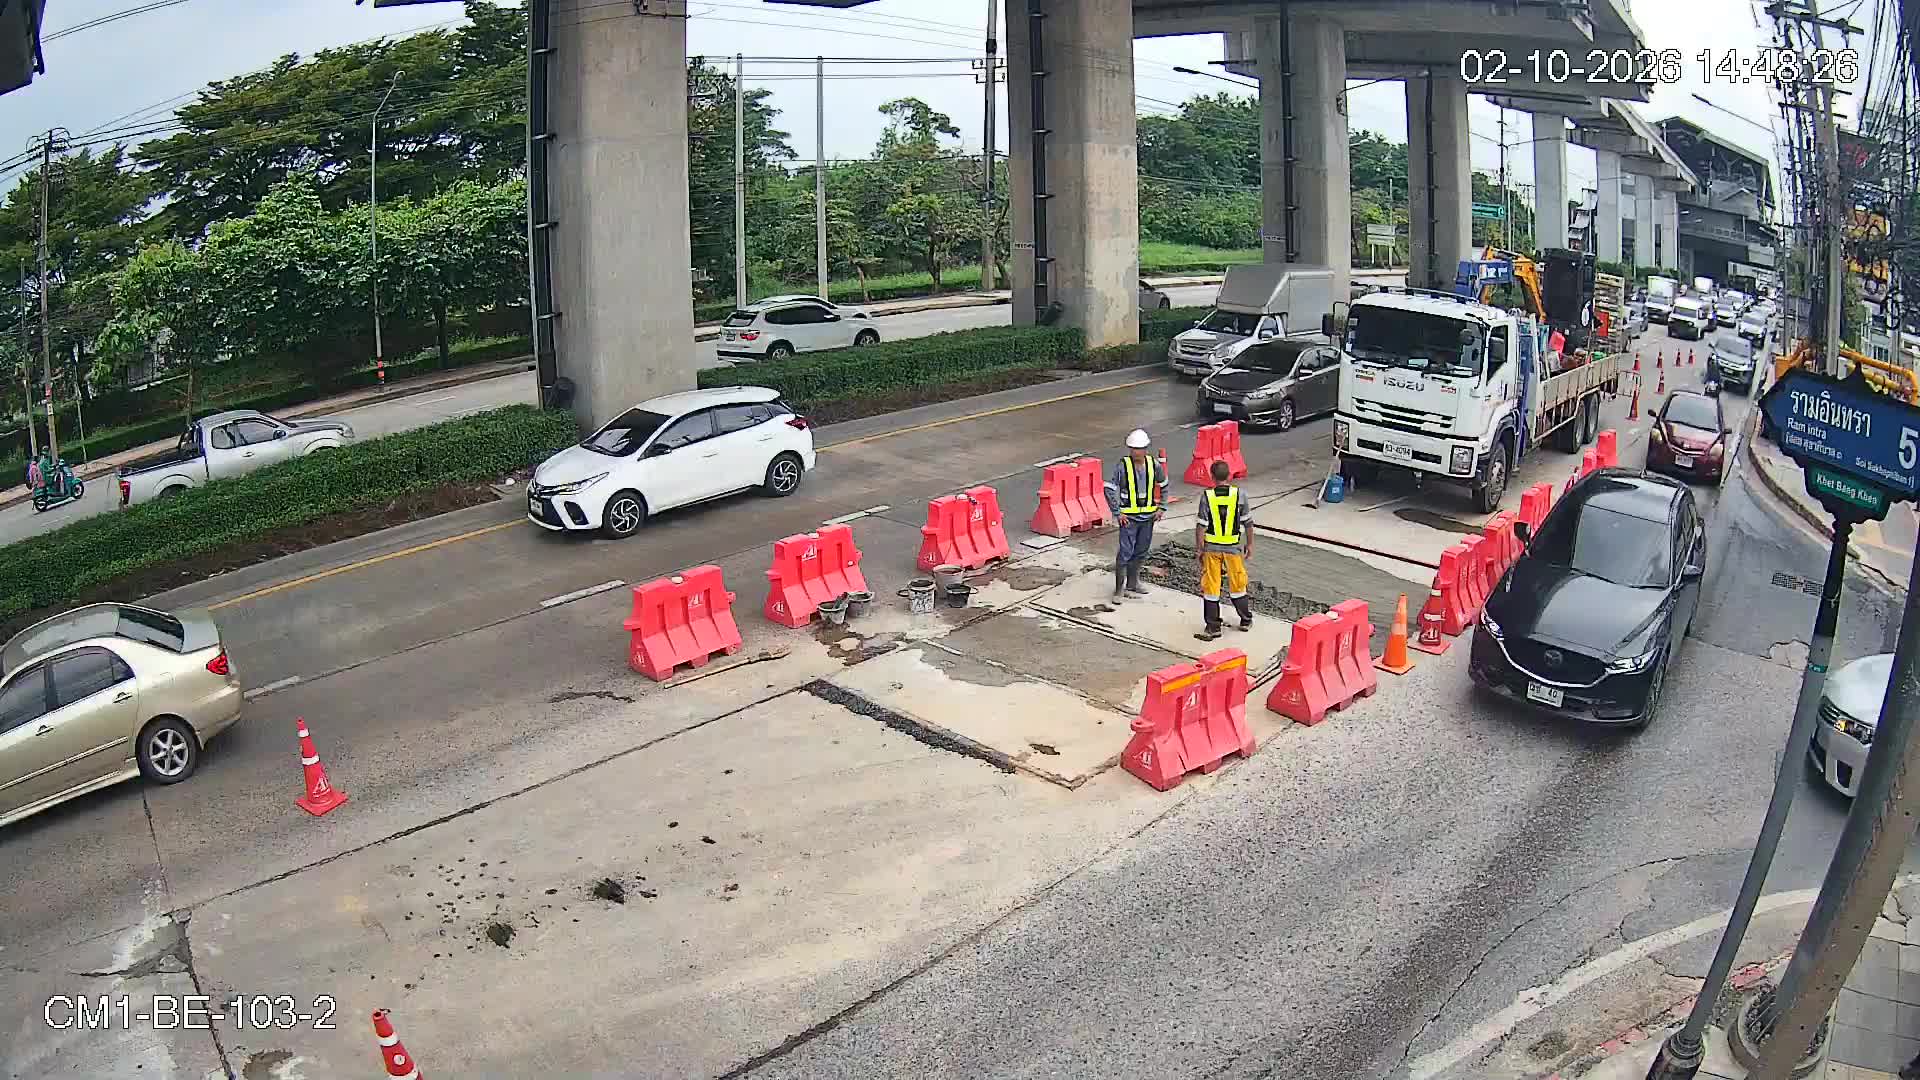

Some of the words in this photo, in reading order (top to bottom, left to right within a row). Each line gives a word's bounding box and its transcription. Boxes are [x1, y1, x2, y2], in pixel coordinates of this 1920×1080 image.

[1384, 377, 1425, 392] ISUZU
[1790, 390, 1871, 438] รามอินทรา
[1787, 417, 1806, 433] Ram
[1898, 426, 1919, 470] 5
[1816, 472, 1834, 489] Khet
